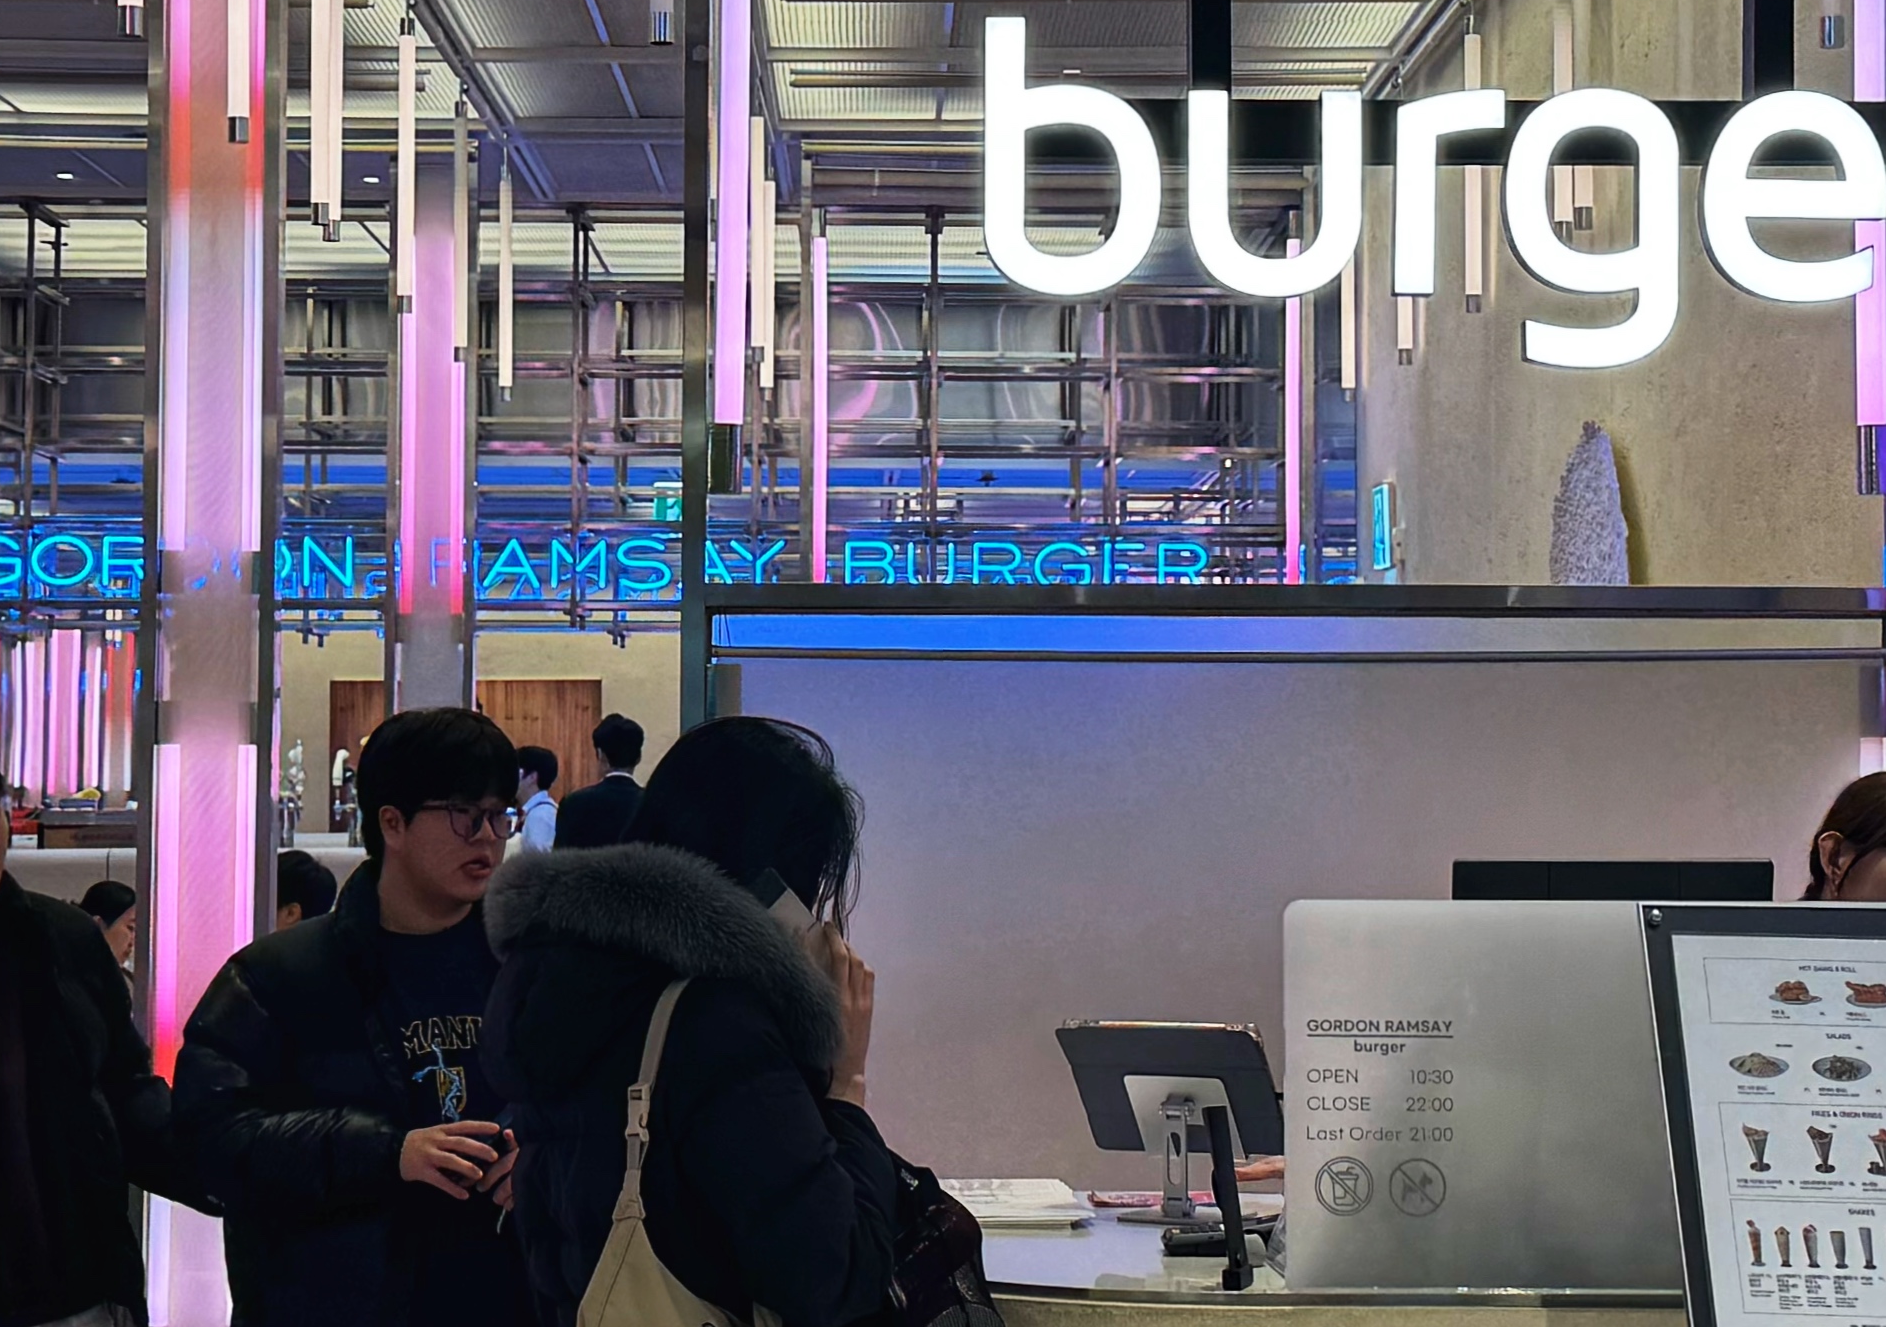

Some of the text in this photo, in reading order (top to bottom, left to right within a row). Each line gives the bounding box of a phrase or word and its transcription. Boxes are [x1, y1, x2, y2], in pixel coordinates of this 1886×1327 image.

[843, 539, 1211, 585] BURGER
[1306, 1019, 1453, 1034] GORDON RAMSAY
[1353, 1039, 1406, 1056] burger
[1306, 1068, 1454, 1085] OPEN 10:30
[1306, 1096, 1454, 1113] CLOSE 22:00
[1306, 1125, 1454, 1143] Last Order 21:00
